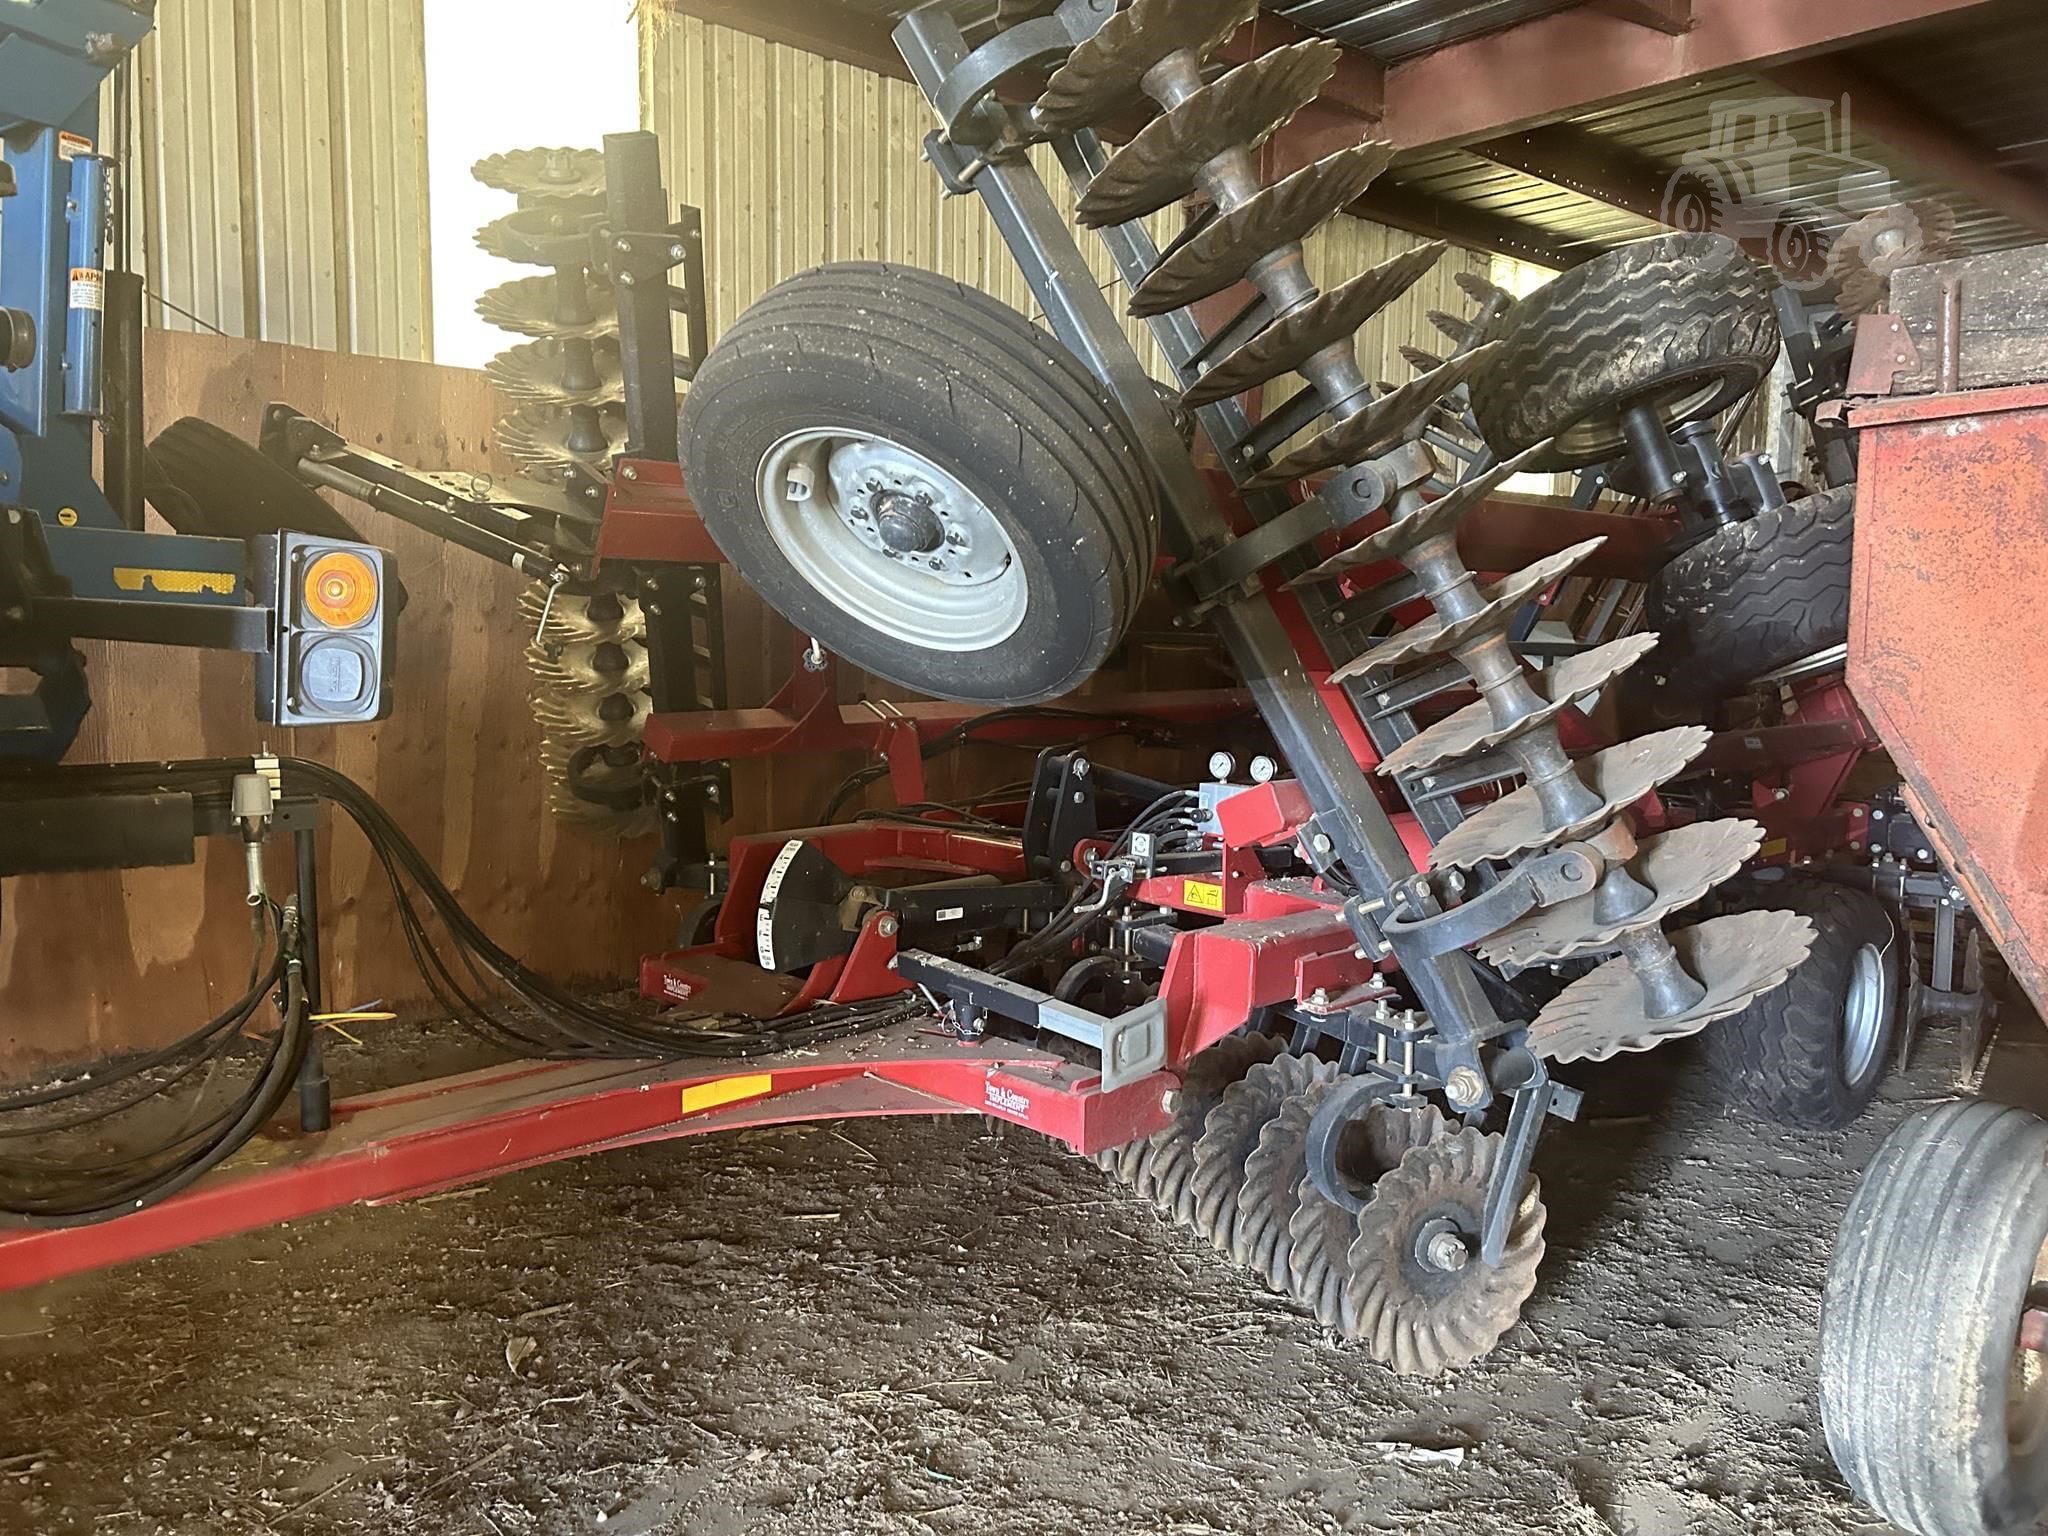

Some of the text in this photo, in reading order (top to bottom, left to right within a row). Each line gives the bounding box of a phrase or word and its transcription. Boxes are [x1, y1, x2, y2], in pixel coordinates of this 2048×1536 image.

[985, 1080, 1000, 1096] Town
[1006, 1089, 1029, 1108] Country
[989, 1093, 1025, 1112] IMPLEMENT
